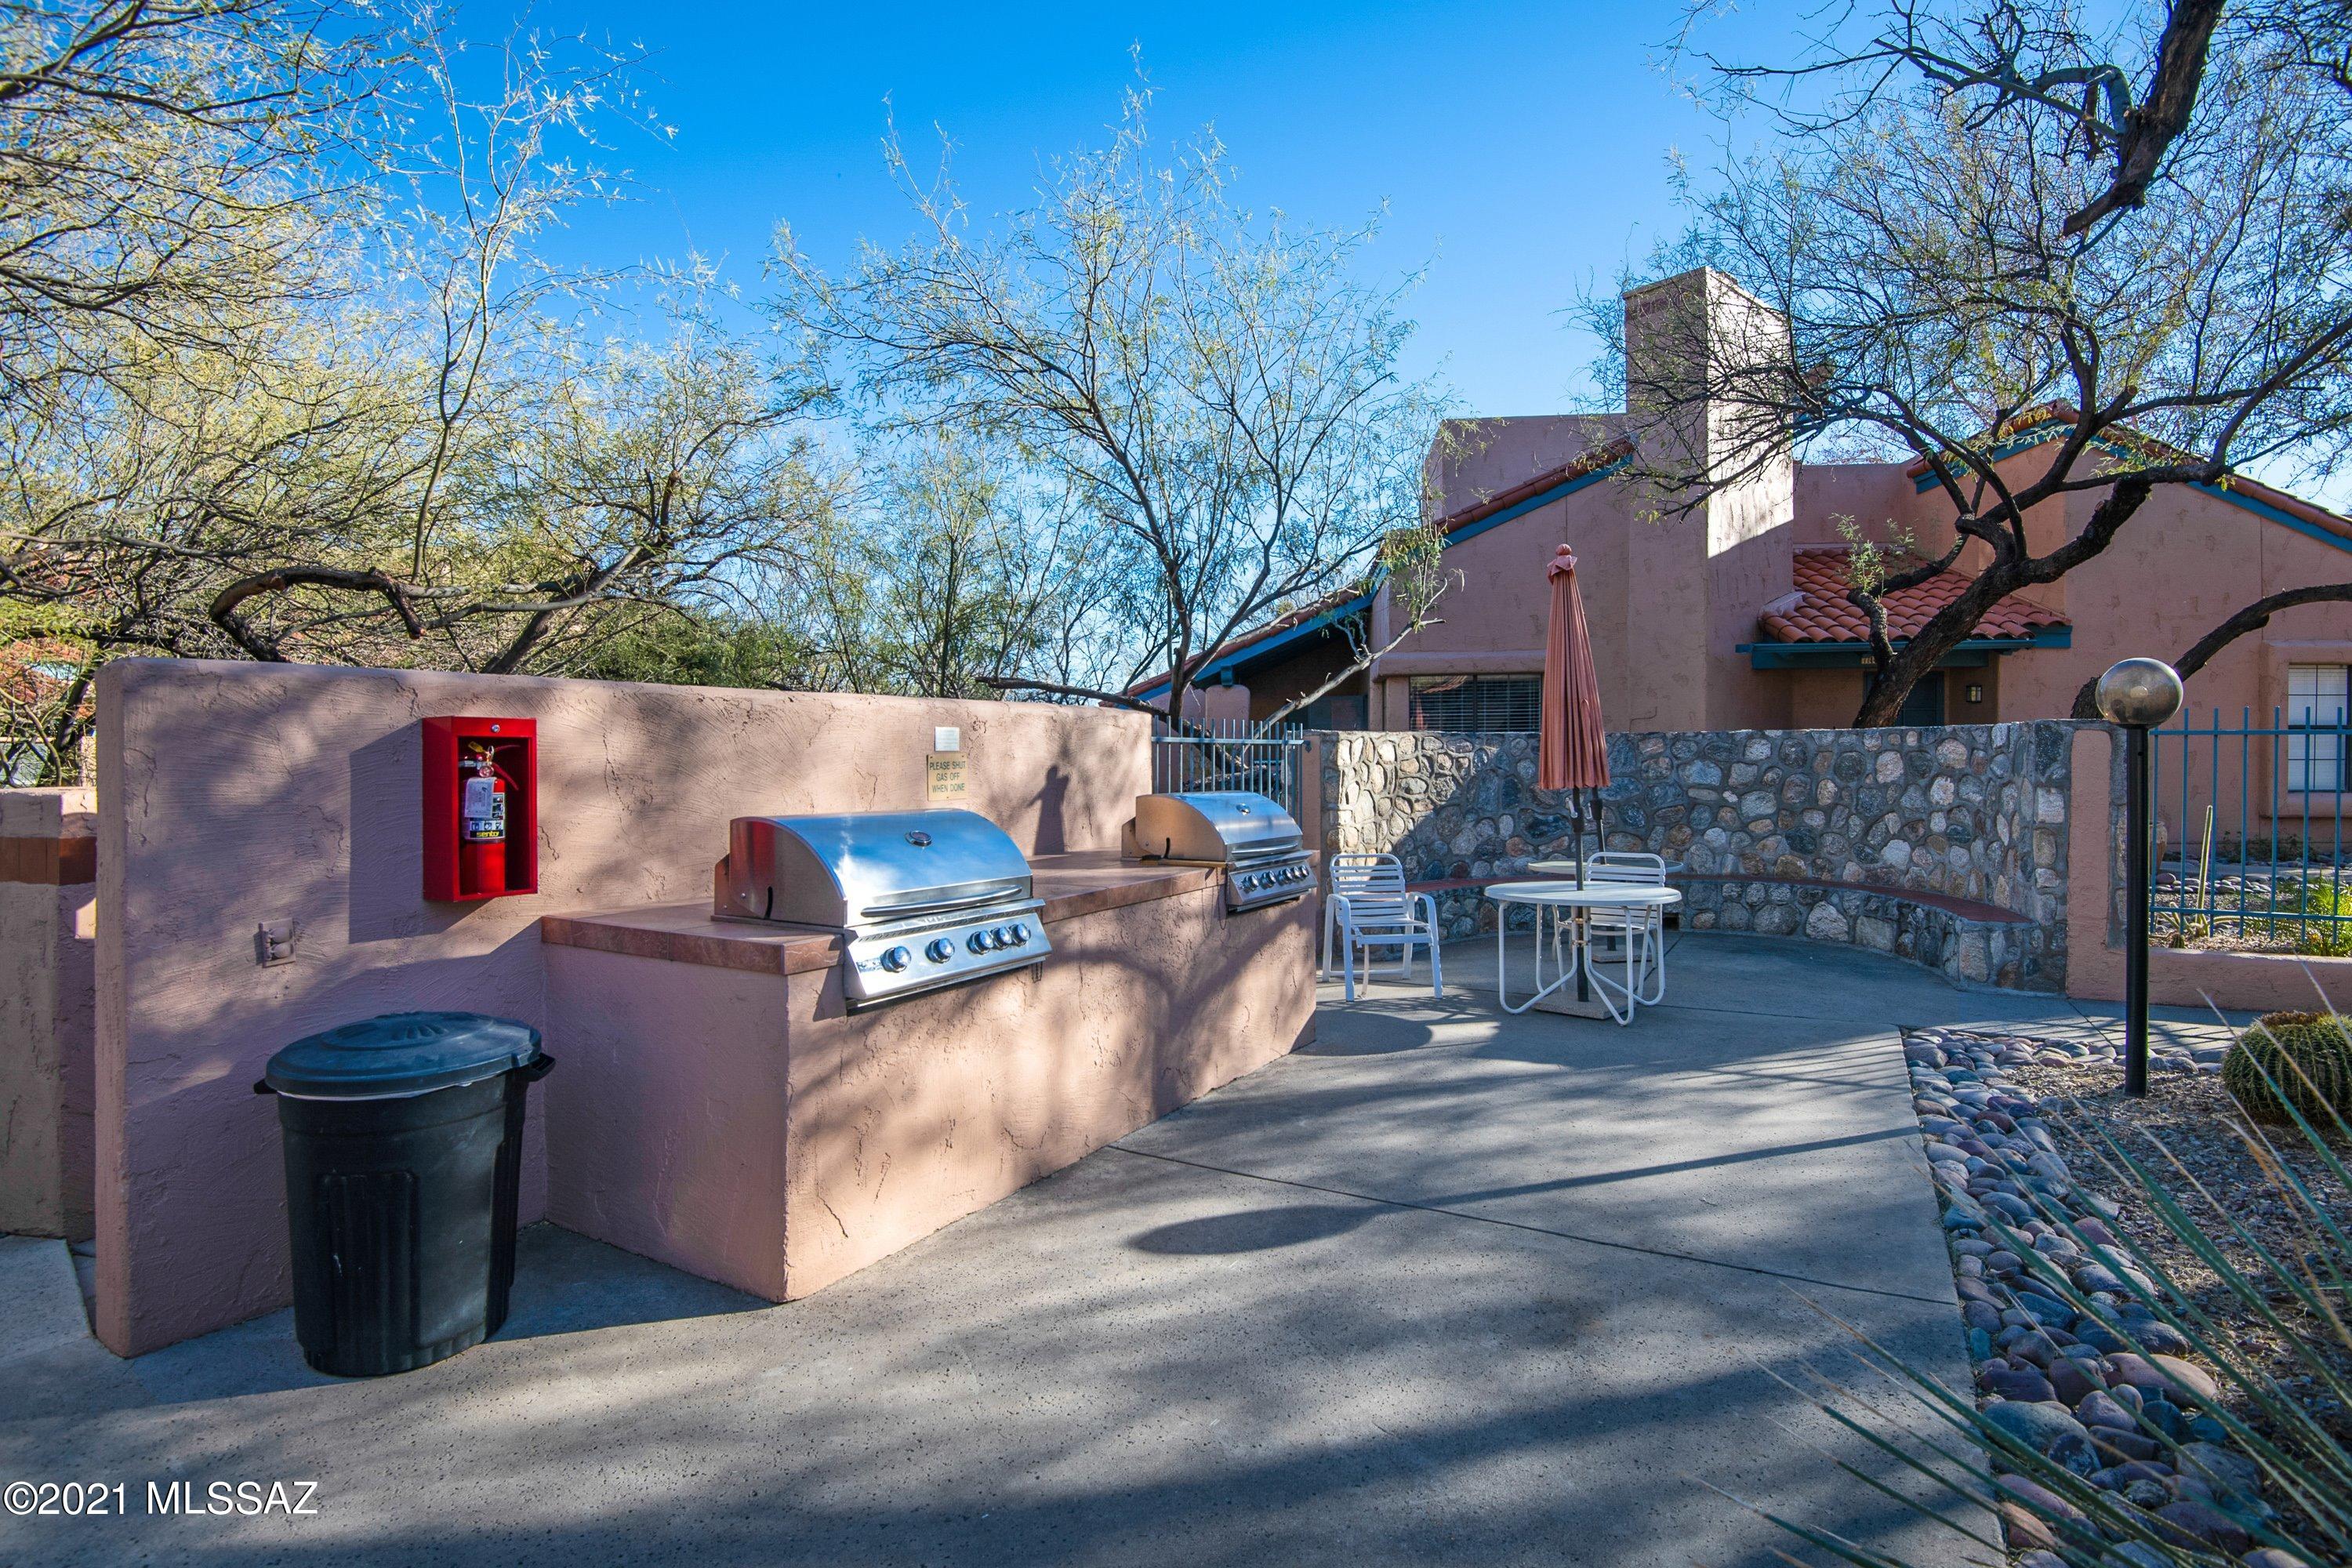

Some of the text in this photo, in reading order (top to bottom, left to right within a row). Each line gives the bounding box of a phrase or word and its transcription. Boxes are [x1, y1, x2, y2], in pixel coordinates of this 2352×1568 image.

[929, 760, 966, 770] PLEASE SHUT
[936, 772, 960, 782] GAS OFF
[932, 783, 965, 793] WHEN DONE
